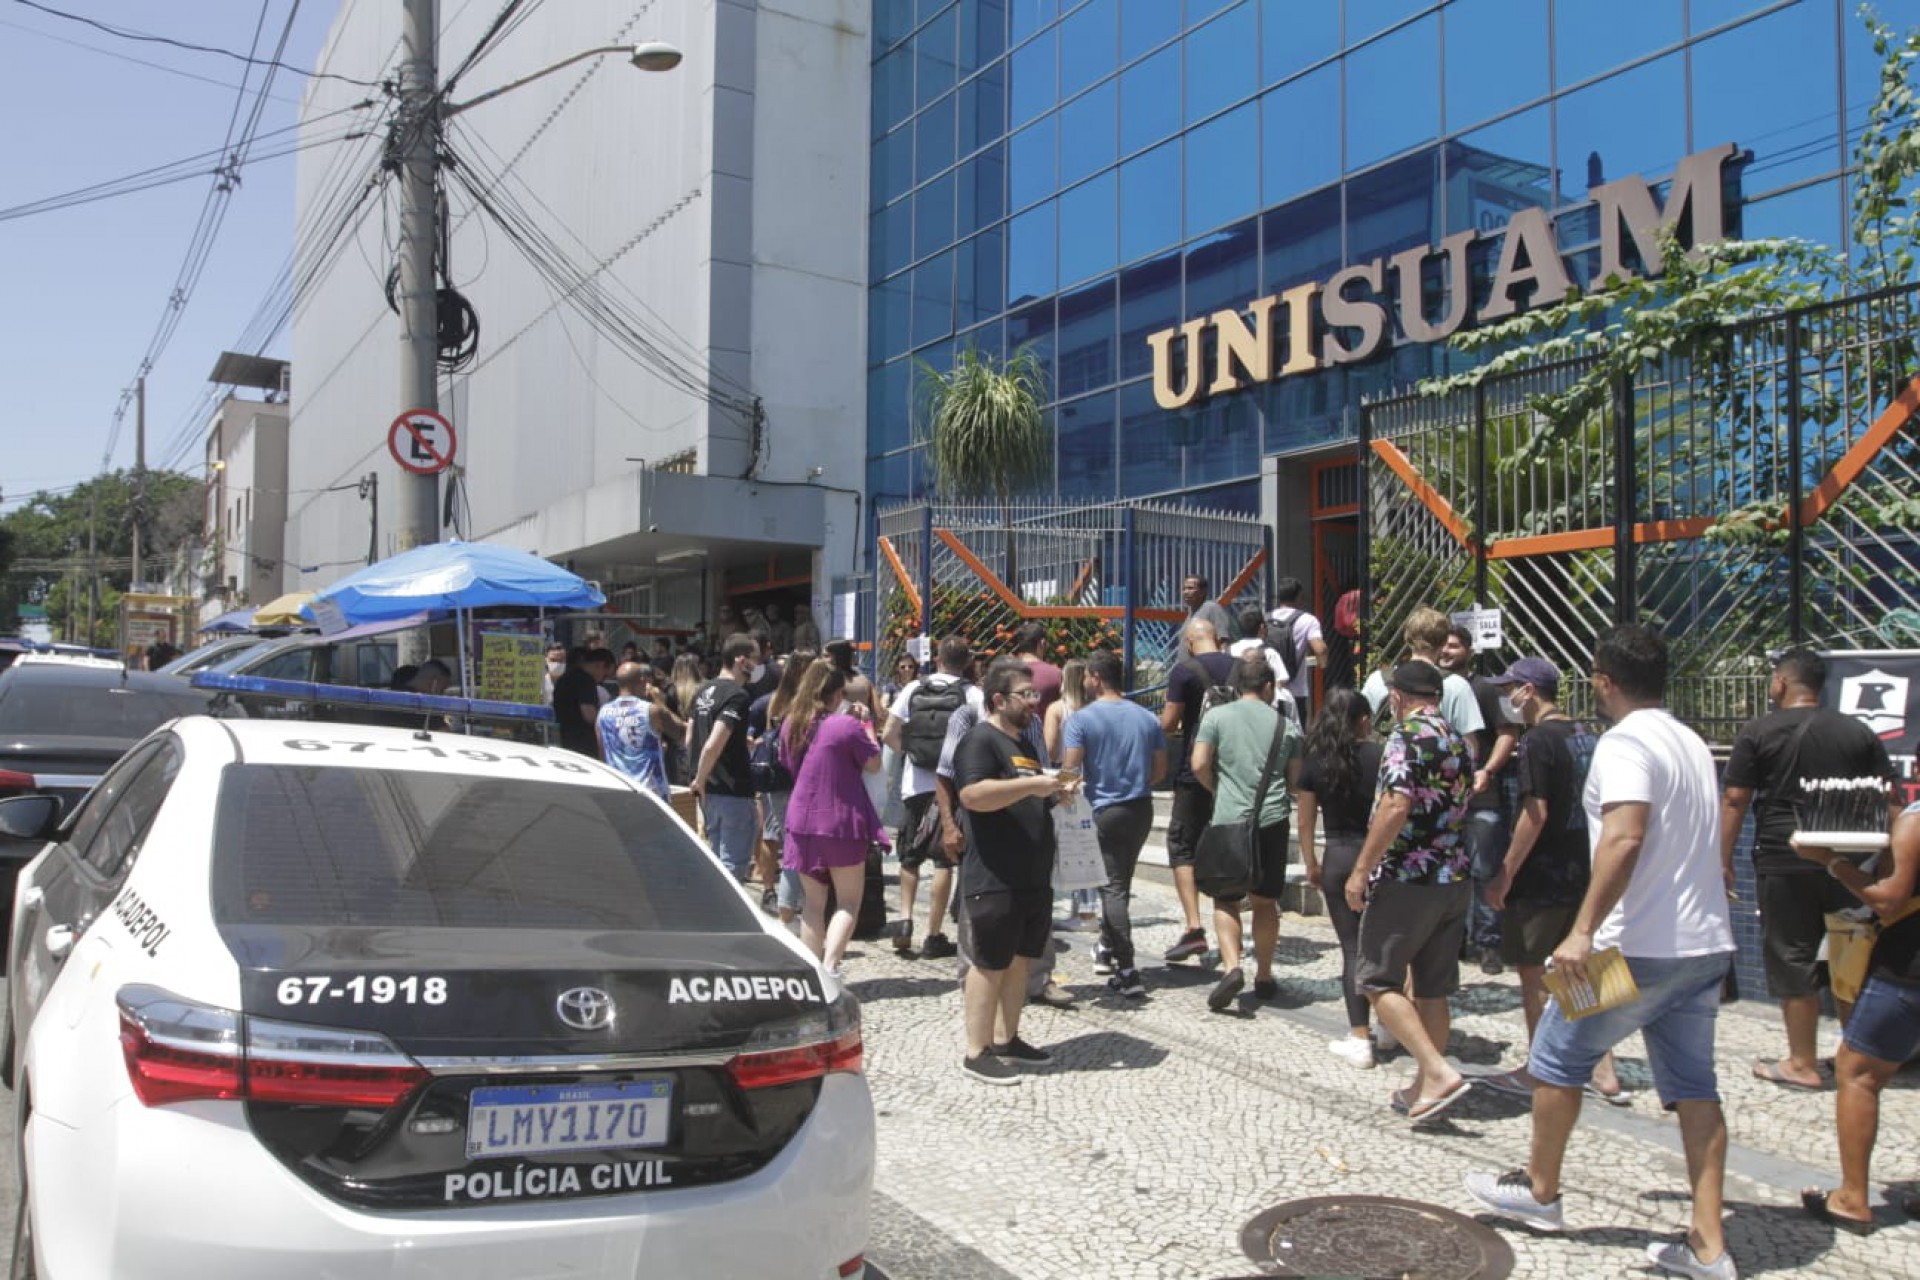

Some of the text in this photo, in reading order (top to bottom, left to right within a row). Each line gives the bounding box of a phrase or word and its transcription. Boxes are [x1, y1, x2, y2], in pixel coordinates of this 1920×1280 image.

[1147, 142, 1752, 409] UNISUAM
[411, 422, 435, 460] E
[282, 738, 590, 774] 67-1918
[112, 886, 171, 958] ACADEPOL
[276, 975, 448, 1006] 67-1918
[668, 975, 821, 1004] ACADEPOL
[487, 1103, 646, 1147] LMY1I70
[445, 1159, 672, 1201] POLÍCIA CIVIL
